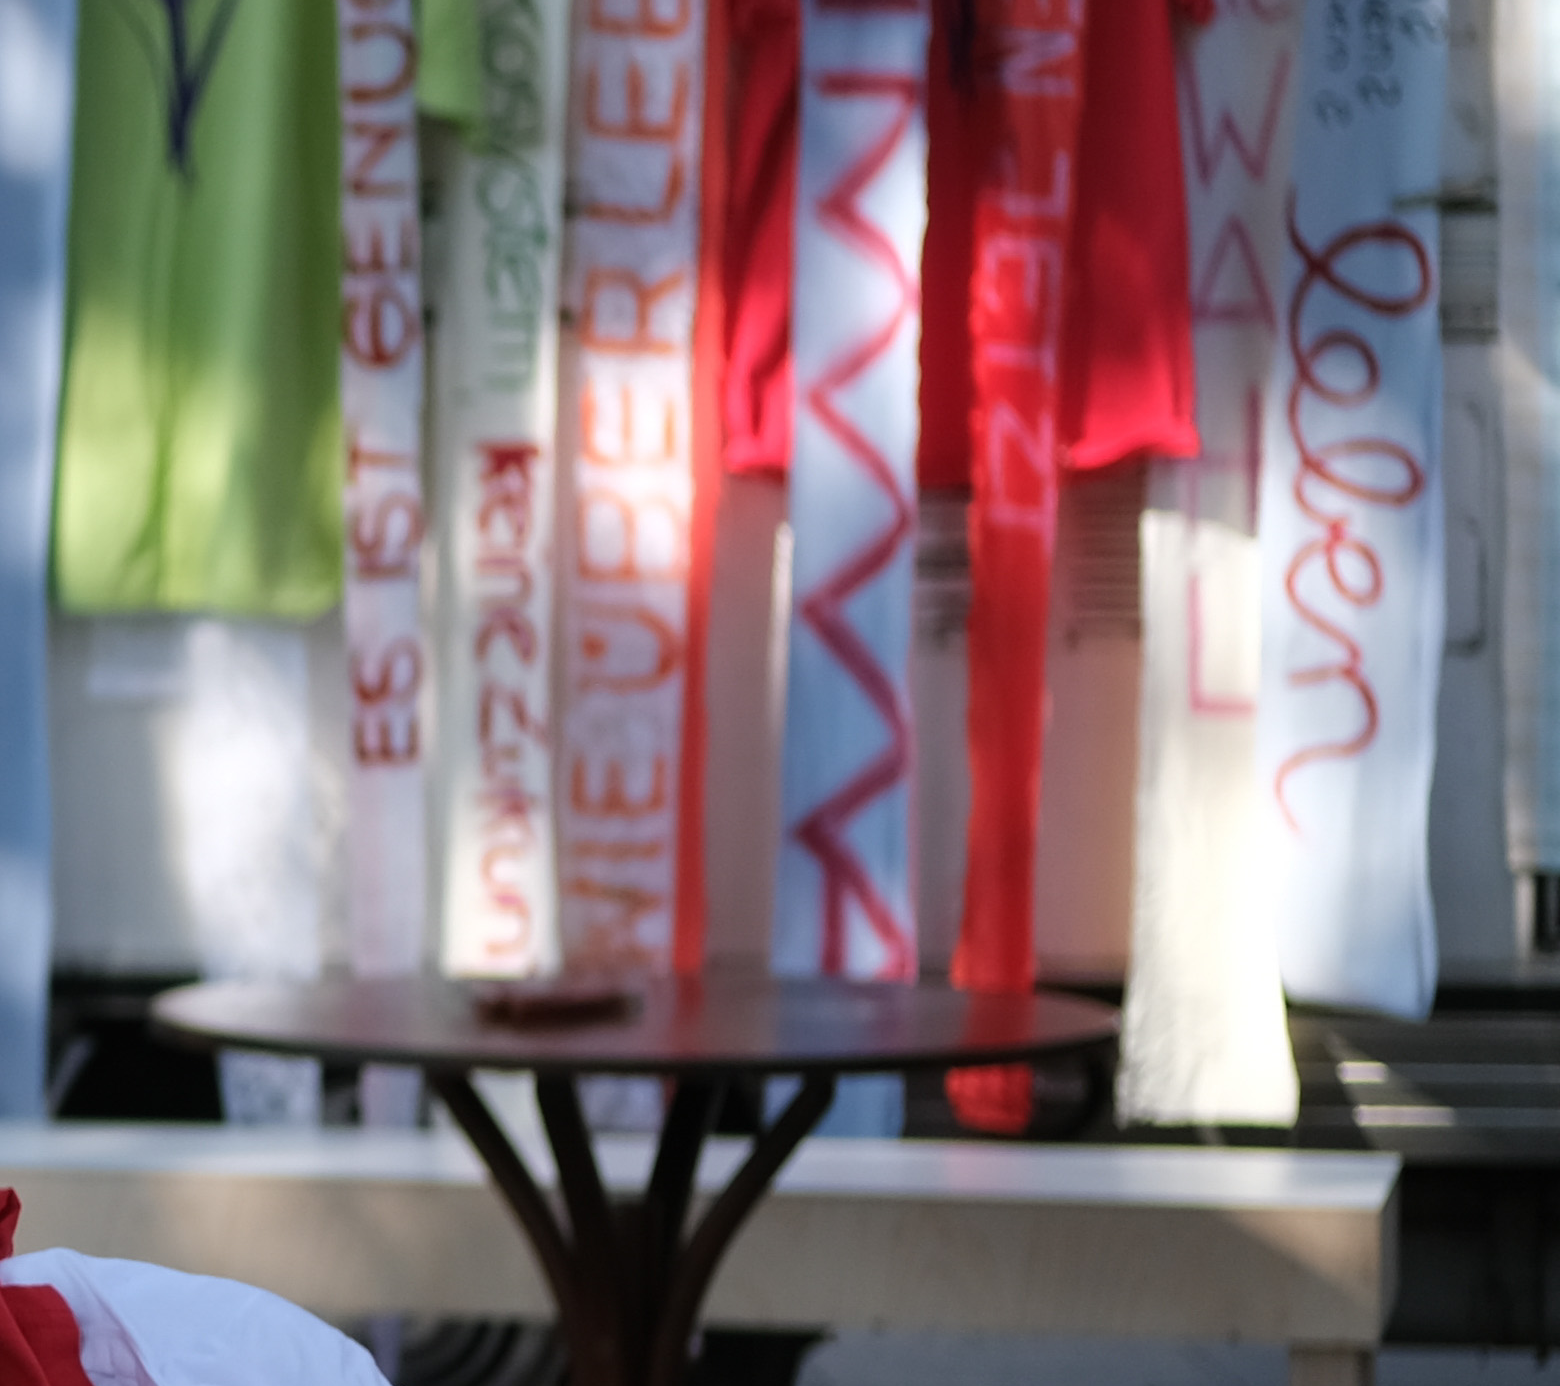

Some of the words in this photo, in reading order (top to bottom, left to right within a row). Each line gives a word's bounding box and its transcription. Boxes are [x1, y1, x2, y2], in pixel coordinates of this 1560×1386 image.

[978, 143, 1077, 549] JETZT
[348, 431, 424, 583] IST
[1274, 190, 1435, 839] leben
[354, 644, 425, 767] ES
